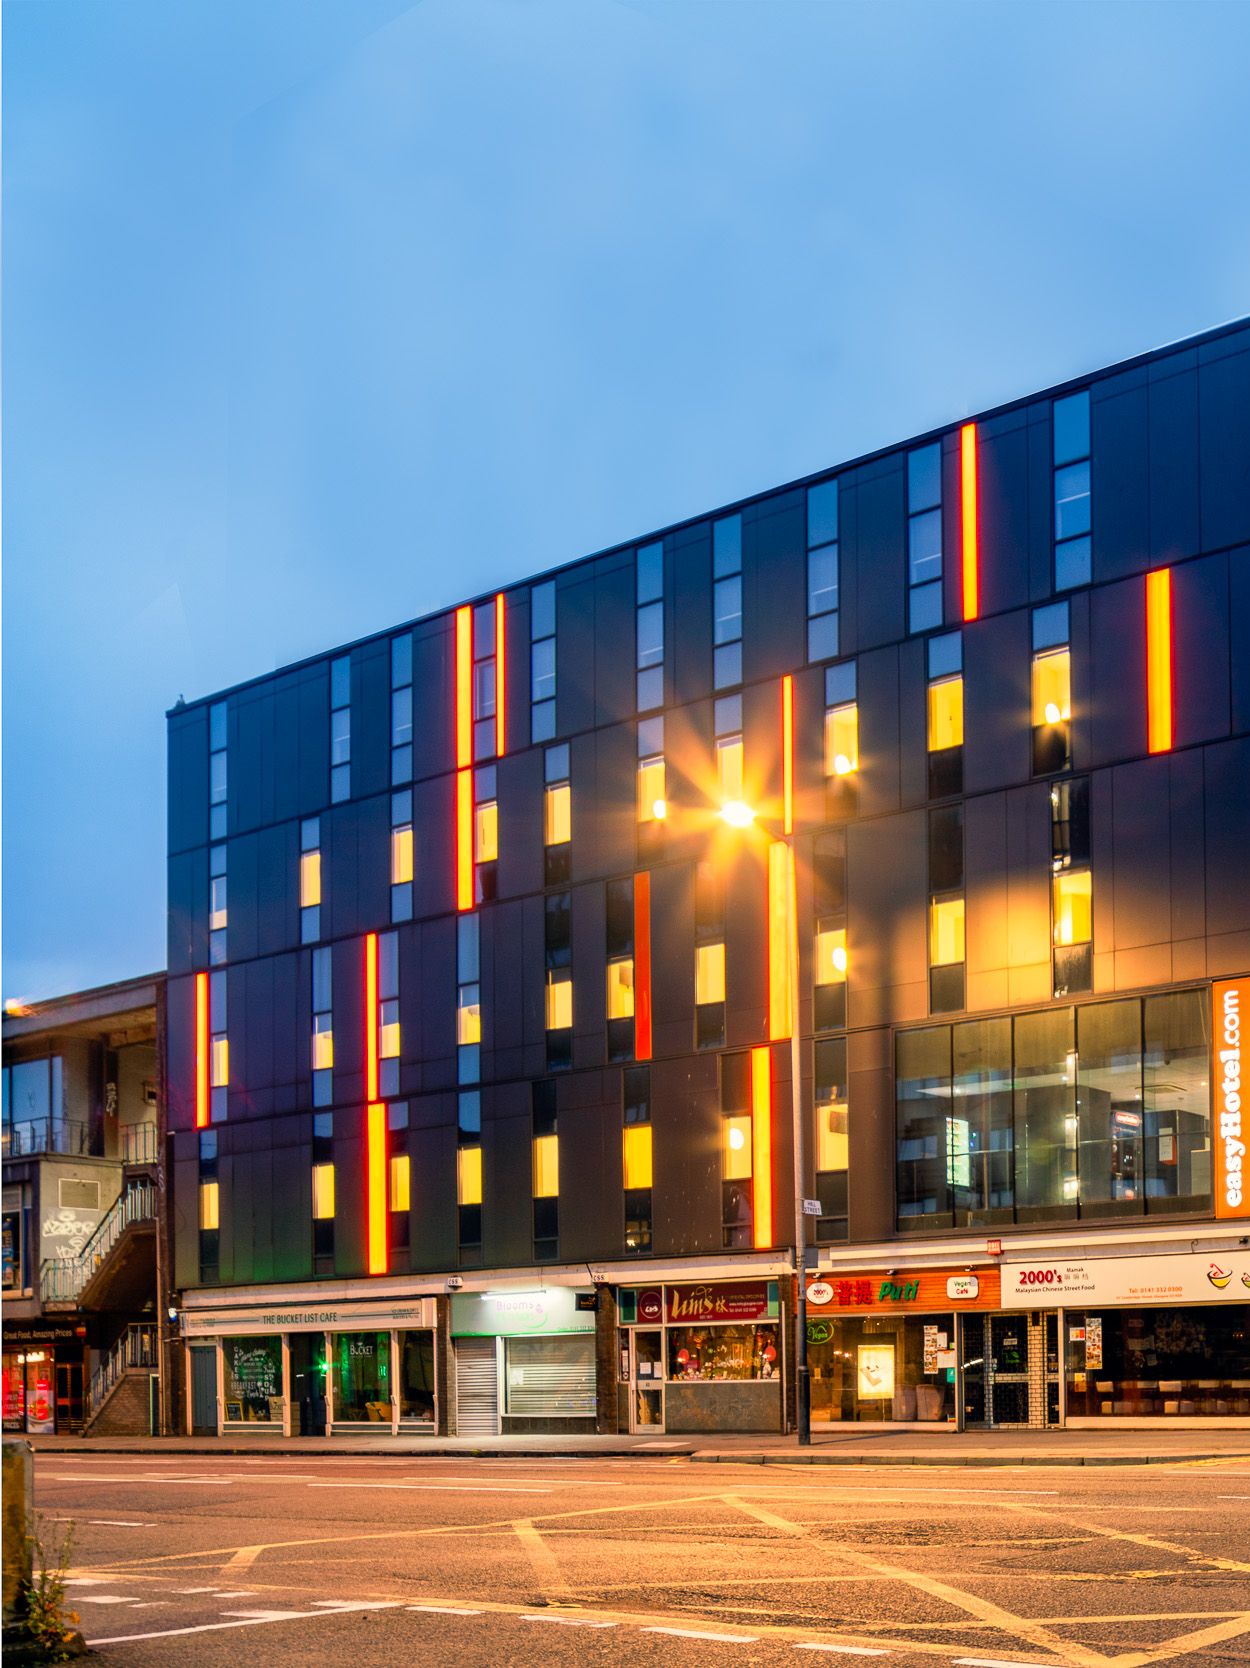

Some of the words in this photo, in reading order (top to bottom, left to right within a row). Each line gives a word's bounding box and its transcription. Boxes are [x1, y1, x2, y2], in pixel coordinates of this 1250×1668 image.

[1220, 990, 1246, 1208] easyHotel.com
[1019, 1269, 1062, 1285] 2000's
[879, 1280, 919, 1301] Puti
[496, 1300, 534, 1312] Blooms
[263, 1315, 275, 1324] THE
[276, 1313, 302, 1324] BUCKET
[304, 1313, 318, 1323] LIST
[319, 1312, 337, 1322] CAFE
[32, 1329, 55, 1340] Amazing
[55, 1328, 73, 1338] Prices
[350, 1344, 373, 1355] BUCKET
